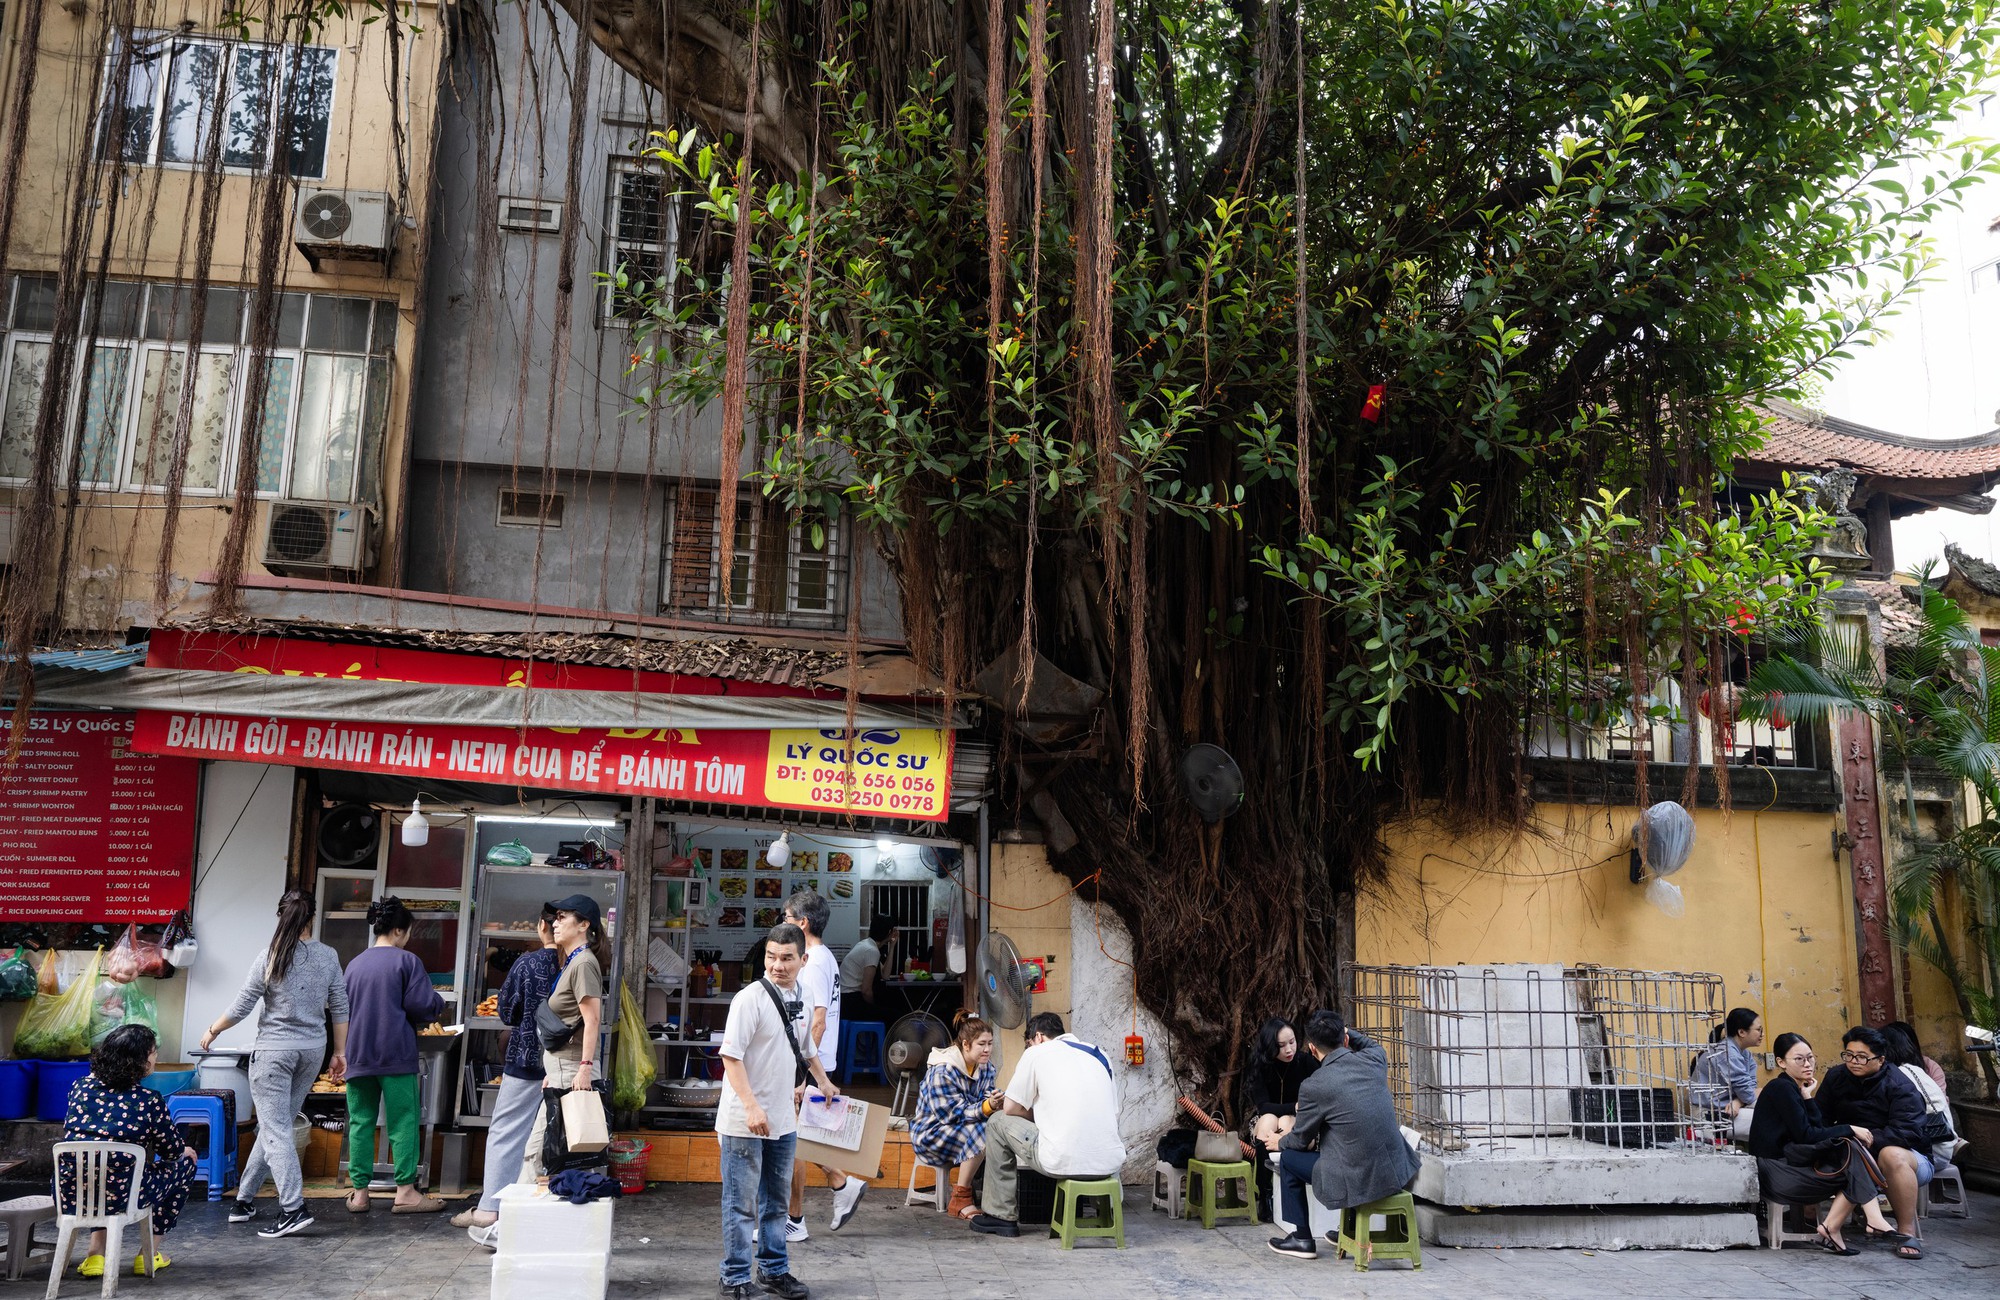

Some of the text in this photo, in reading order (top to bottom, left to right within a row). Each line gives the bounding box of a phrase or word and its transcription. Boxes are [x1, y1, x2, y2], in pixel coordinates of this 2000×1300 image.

[29, 718, 49, 730] 52
[53, 717, 72, 733] Lý
[76, 717, 120, 733] Quốc
[166, 712, 239, 752] BÁNH
[244, 717, 289, 756] GÔI
[303, 721, 374, 762] BÁNH
[379, 728, 434, 768] RÁN
[448, 739, 507, 775] NEM
[513, 745, 562, 780] CUA
[569, 739, 605, 783] BỂ
[617, 749, 687, 791] BÁNH
[693, 755, 746, 796] TÔM
[786, 742, 929, 770] LÝ QUỐC SƯ
[143, 763, 156, 772] CÁI
[2, 776, 22, 784] NGỌT
[142, 776, 154, 784] CÁI
[776, 765, 935, 793] ĐT: 0946 656 056
[61, 790, 88, 798] PASTRY
[143, 790, 156, 798] CÁI
[811, 787, 934, 811] 033 250 0978
[163, 804, 184, 812] (4CÁI)
[0, 815, 16, 823] THỊT
[137, 829, 150, 837] CÁI
[140, 842, 153, 850] CÁI
[136, 855, 149, 863] CÁI
[160, 869, 180, 877] (5CÁI)
